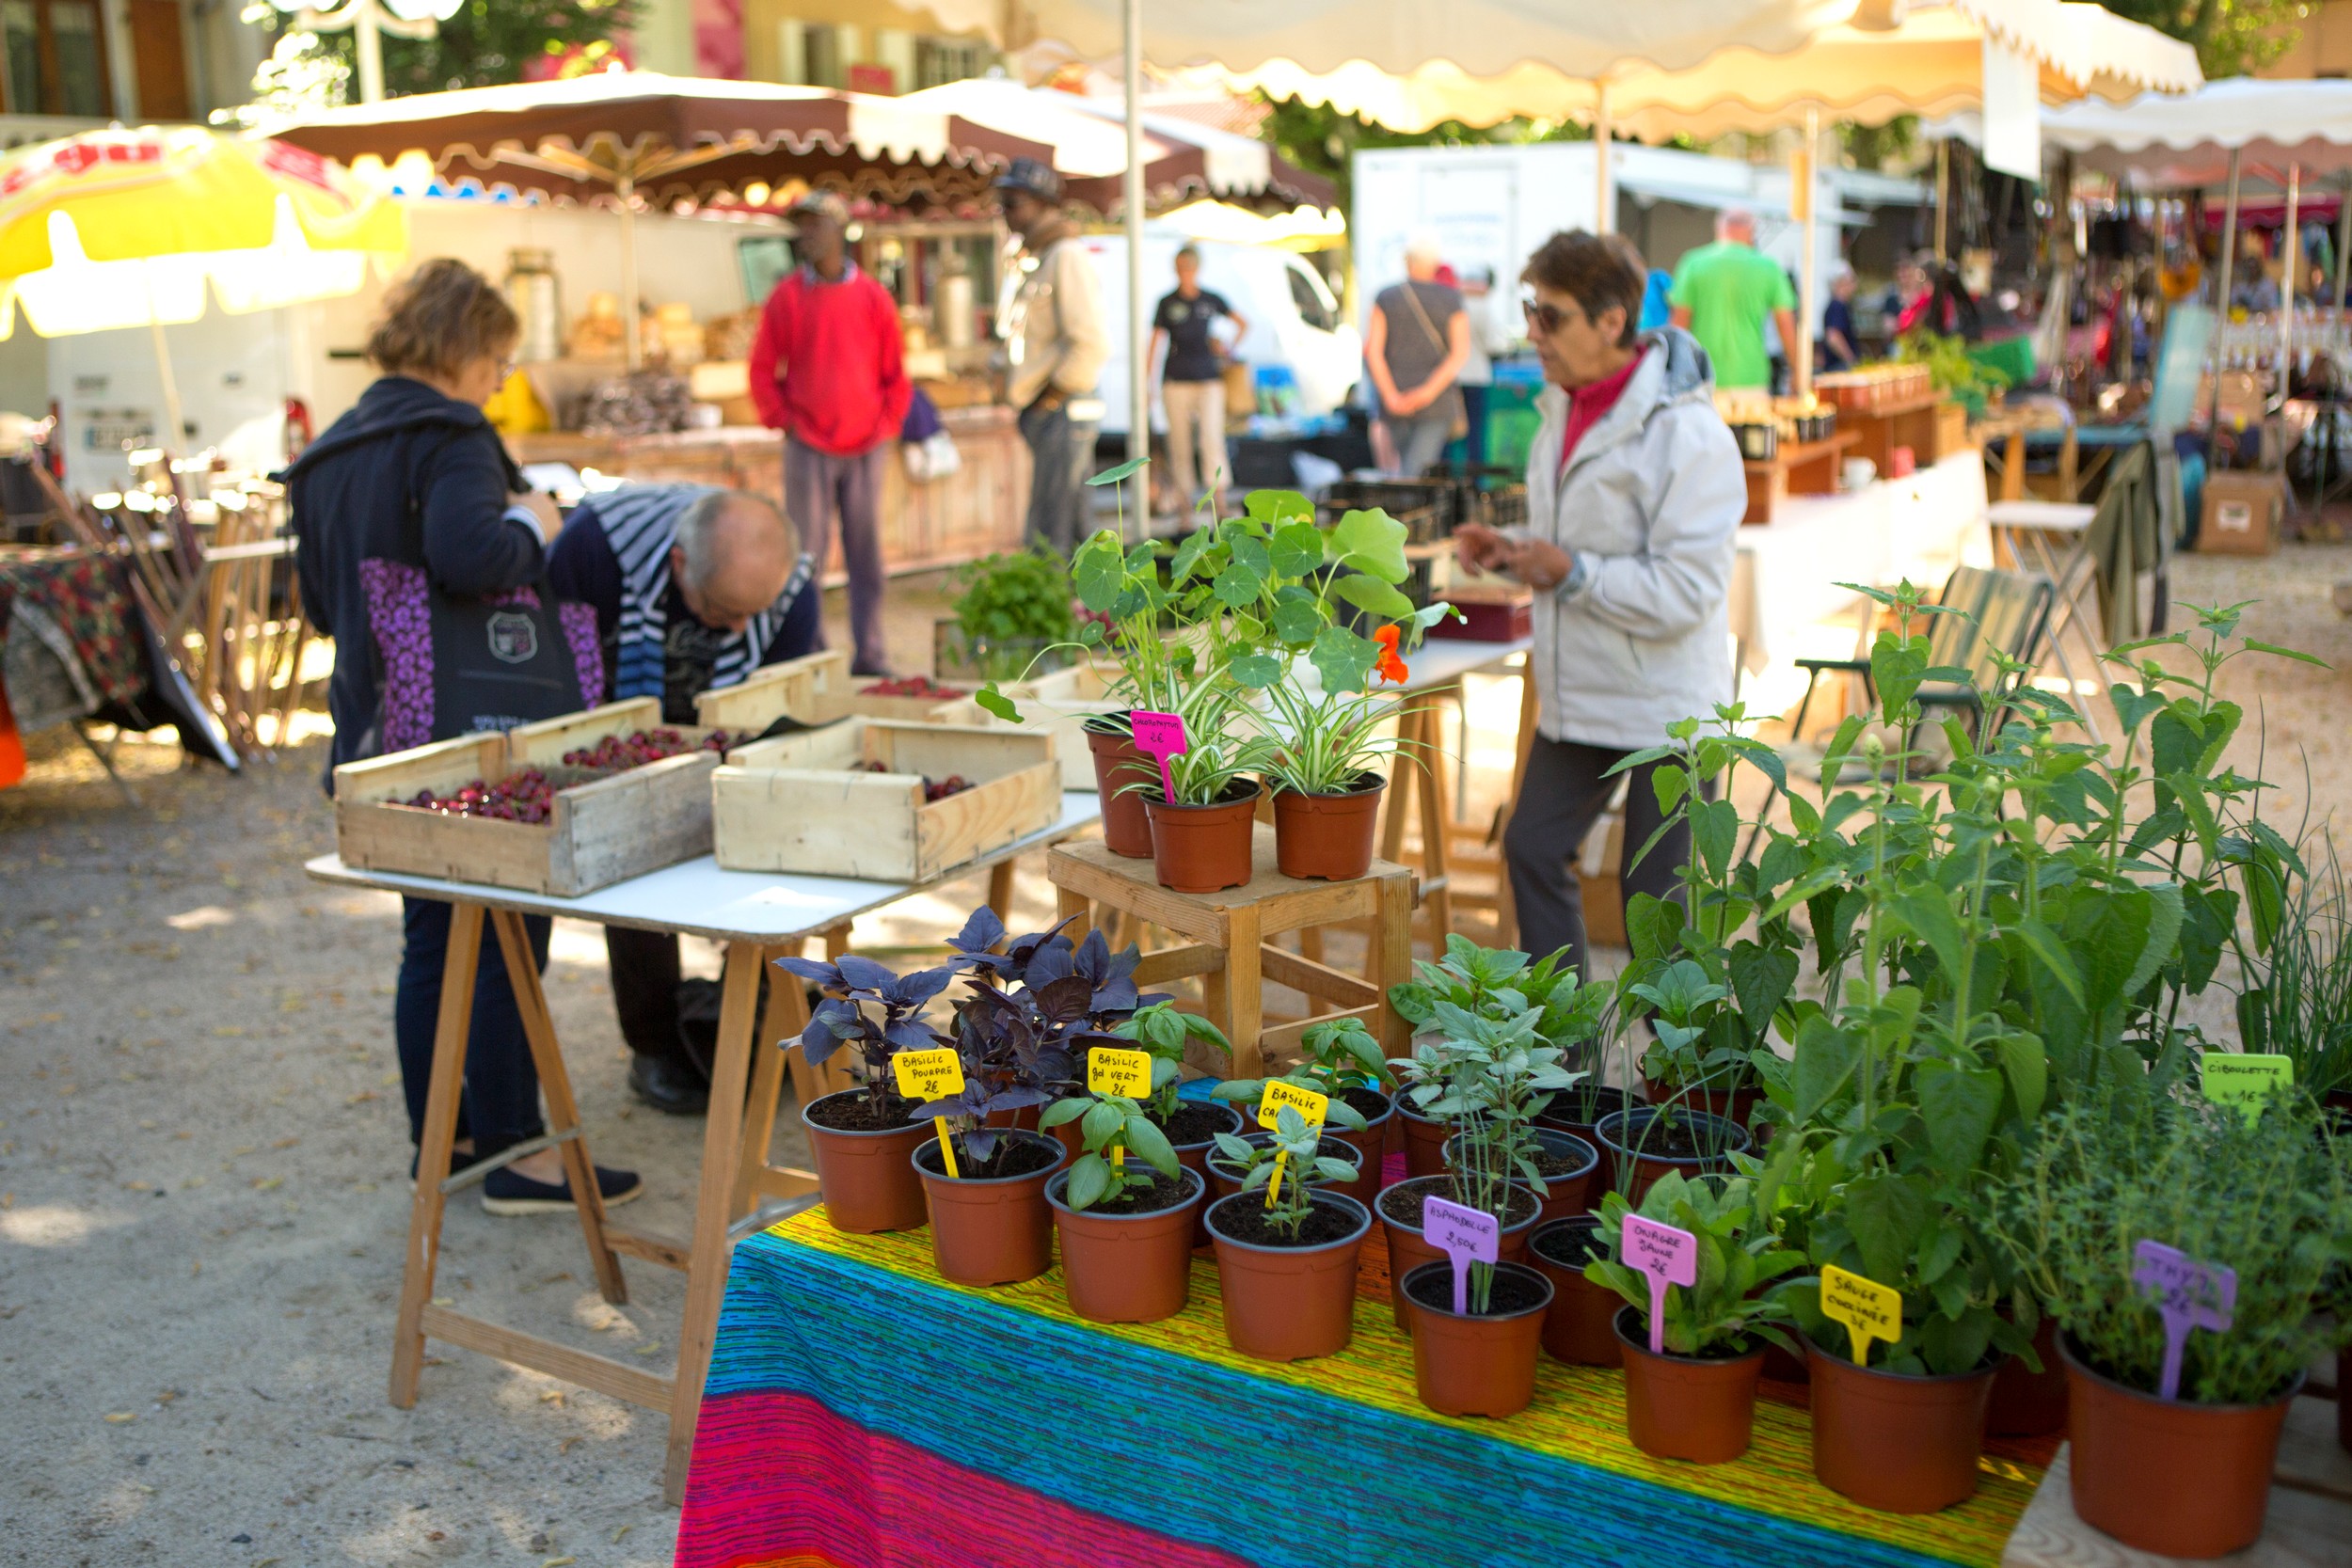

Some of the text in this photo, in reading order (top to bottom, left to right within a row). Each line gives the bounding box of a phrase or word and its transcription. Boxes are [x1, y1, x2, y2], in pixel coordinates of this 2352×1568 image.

[1150, 733, 1165, 743] 2€
[912, 1066, 953, 1079] POURPRE
[1110, 1070, 1139, 1082] VERT
[924, 1080, 940, 1094] 2€
[1111, 1083, 1126, 1098] 2€
[1430, 1206, 1491, 1234] ASPHODELLE
[1446, 1231, 1478, 1253] 2,50€
[1634, 1226, 1681, 1248] ONAGRE
[1638, 1239, 1674, 1259] JAUNE
[1650, 1258, 1668, 1276] 2€
[1835, 1276, 1879, 1303] SAUGE
